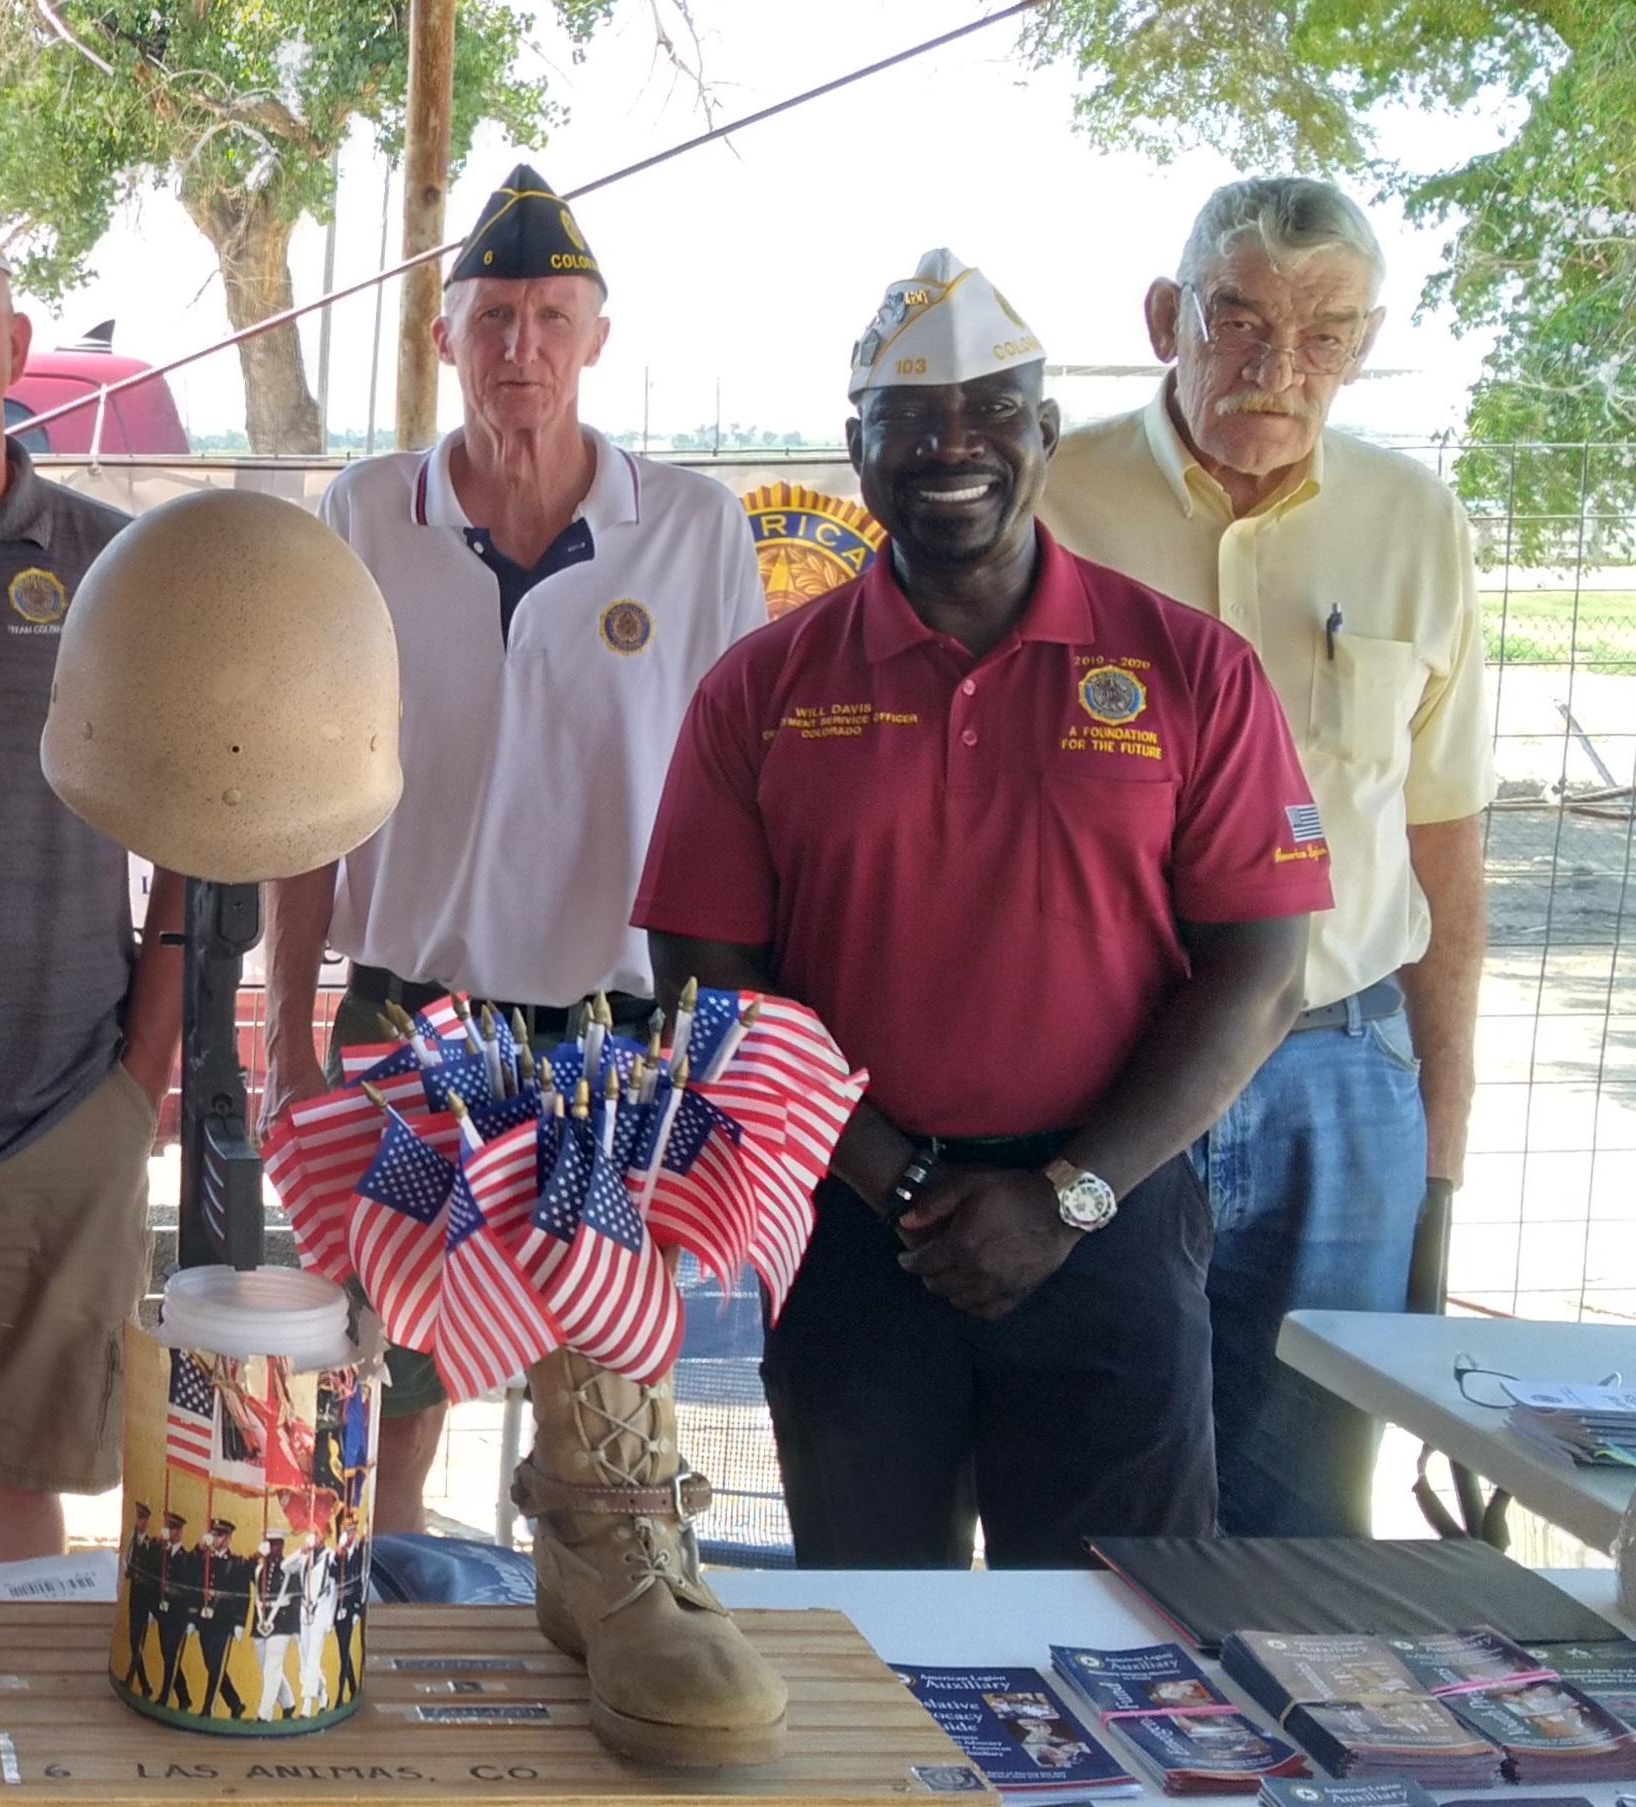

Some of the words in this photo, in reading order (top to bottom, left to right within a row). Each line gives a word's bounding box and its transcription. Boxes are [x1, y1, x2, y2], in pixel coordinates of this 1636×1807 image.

[483, 249, 494, 266] 6
[903, 290, 929, 304] ARMY
[895, 357, 927, 375] 103
[1119, 656, 1152, 671] 2020
[795, 707, 825, 718] WILL
[831, 703, 872, 715] DAVIS
[801, 726, 862, 740] COLORADO
[1068, 726, 1078, 738] A
[1082, 728, 1159, 746] FOUNDATION
[1061, 739, 1086, 751] FOR
[1091, 740, 1115, 753] THE
[1118, 742, 1164, 762] FUTURE
[1111, 1659, 1178, 1671] Auxiliary
[920, 1673, 967, 1683] American
[968, 1673, 1006, 1683] Legion
[925, 1679, 1011, 1691] Auxiliary
[43, 1764, 72, 1779] 6
[136, 1763, 220, 1780] LAS
[469, 1764, 540, 1781] CO
[1332, 1790, 1408, 1804] Auxiliary
